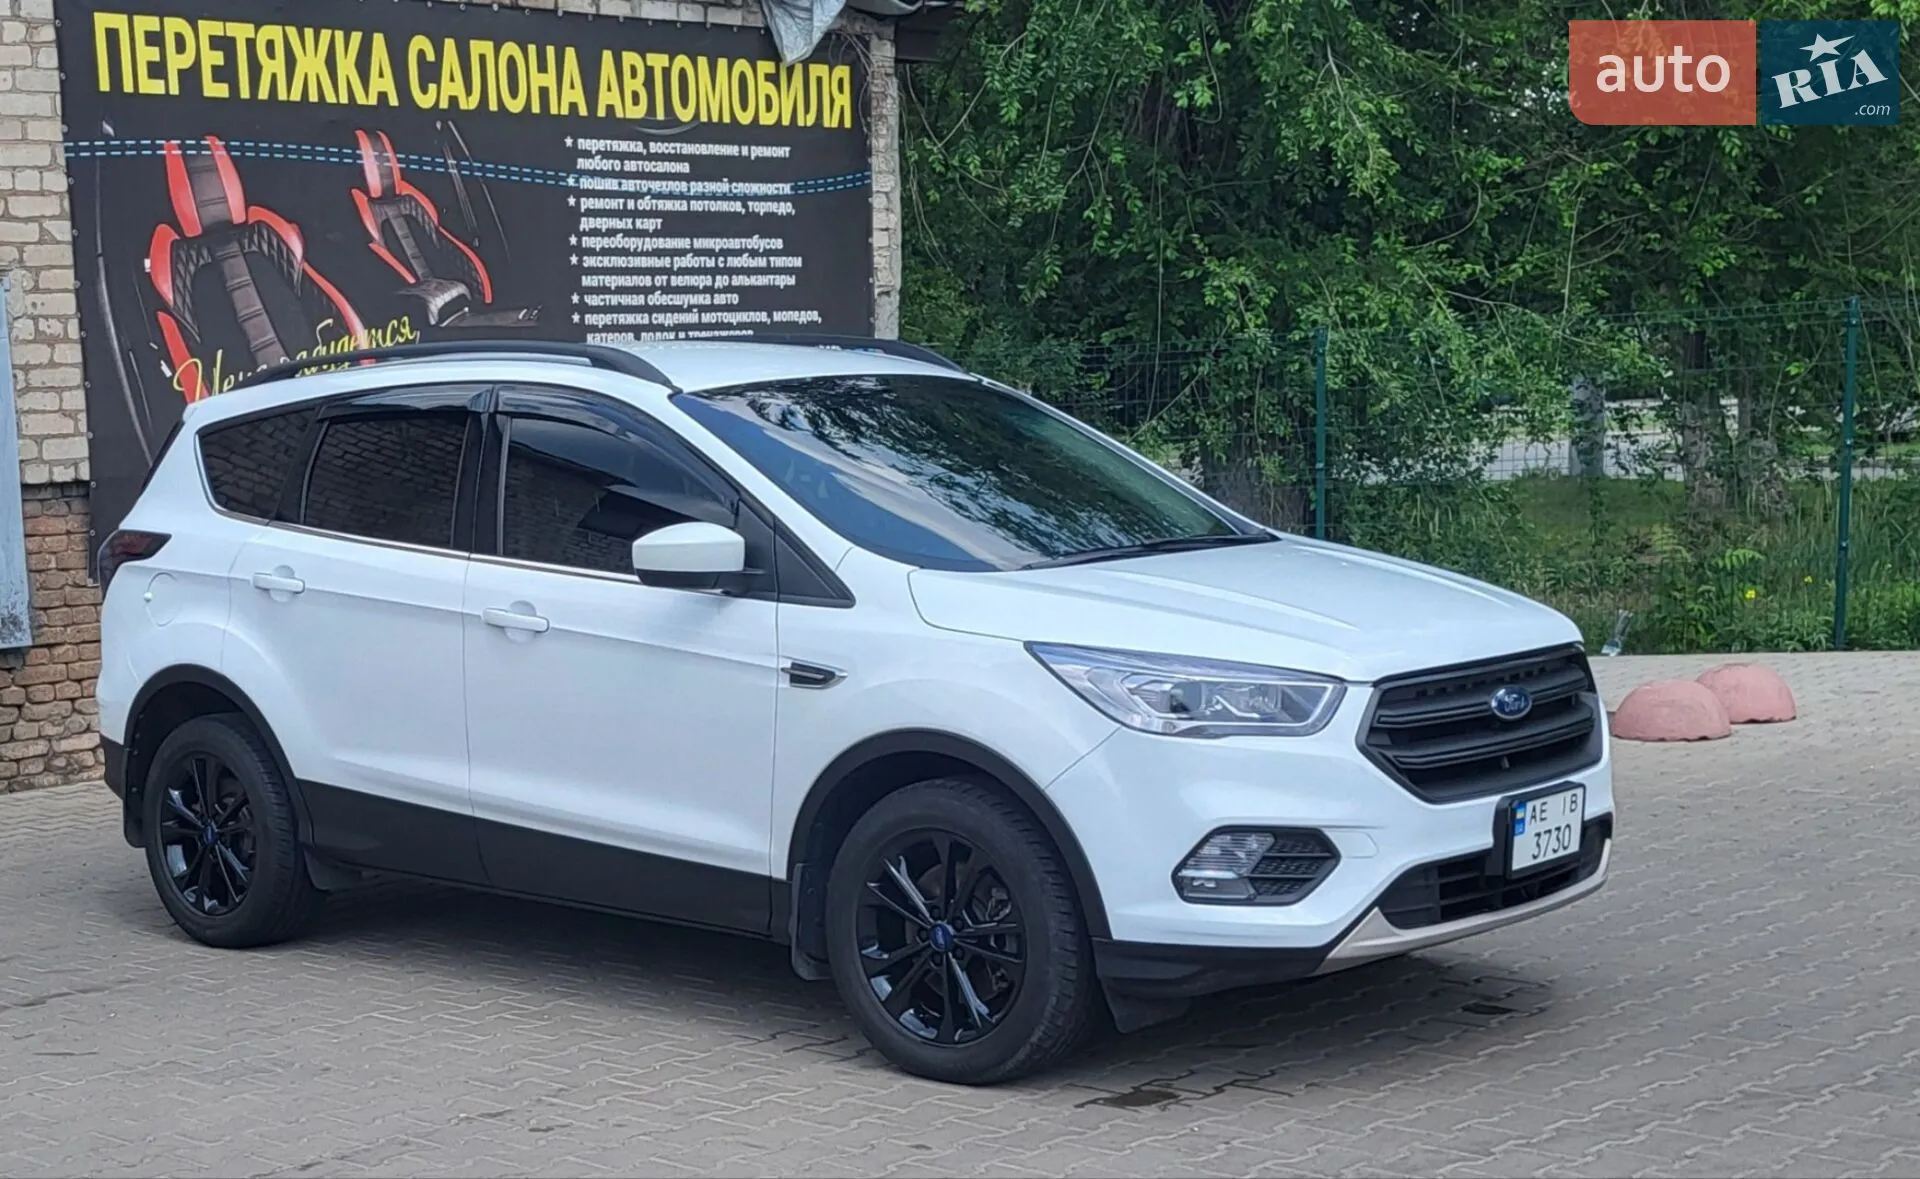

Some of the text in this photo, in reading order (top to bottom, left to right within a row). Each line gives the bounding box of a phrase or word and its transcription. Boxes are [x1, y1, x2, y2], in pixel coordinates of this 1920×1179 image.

[93, 12, 851, 128] ПЕРЕТЯЖКА САЛОНА АВТОМОБИЛЯ
[577, 138, 791, 160] перетяжка, восстановление и ремонт
[576, 155, 690, 173] любого автосалона
[579, 177, 620, 190] пошив
[620, 180, 688, 193] авточехлов
[689, 178, 730, 196] разной
[580, 196, 796, 217] ремонт и обтяжка потолков, торпедо,
[579, 217, 663, 233] дверных карт
[582, 234, 784, 253] переоборудование микроавтобусов
[582, 252, 802, 271] эксклюзивные работы с любым типом
[581, 275, 796, 290] материалов от велюра до алькантары
[583, 290, 739, 309] частичная обесшумка авто
[584, 308, 822, 328] перетяжка сидений мотоциклов, мопедов,
[1529, 793, 1578, 825] AE IB
[1531, 823, 1572, 861] 3730
